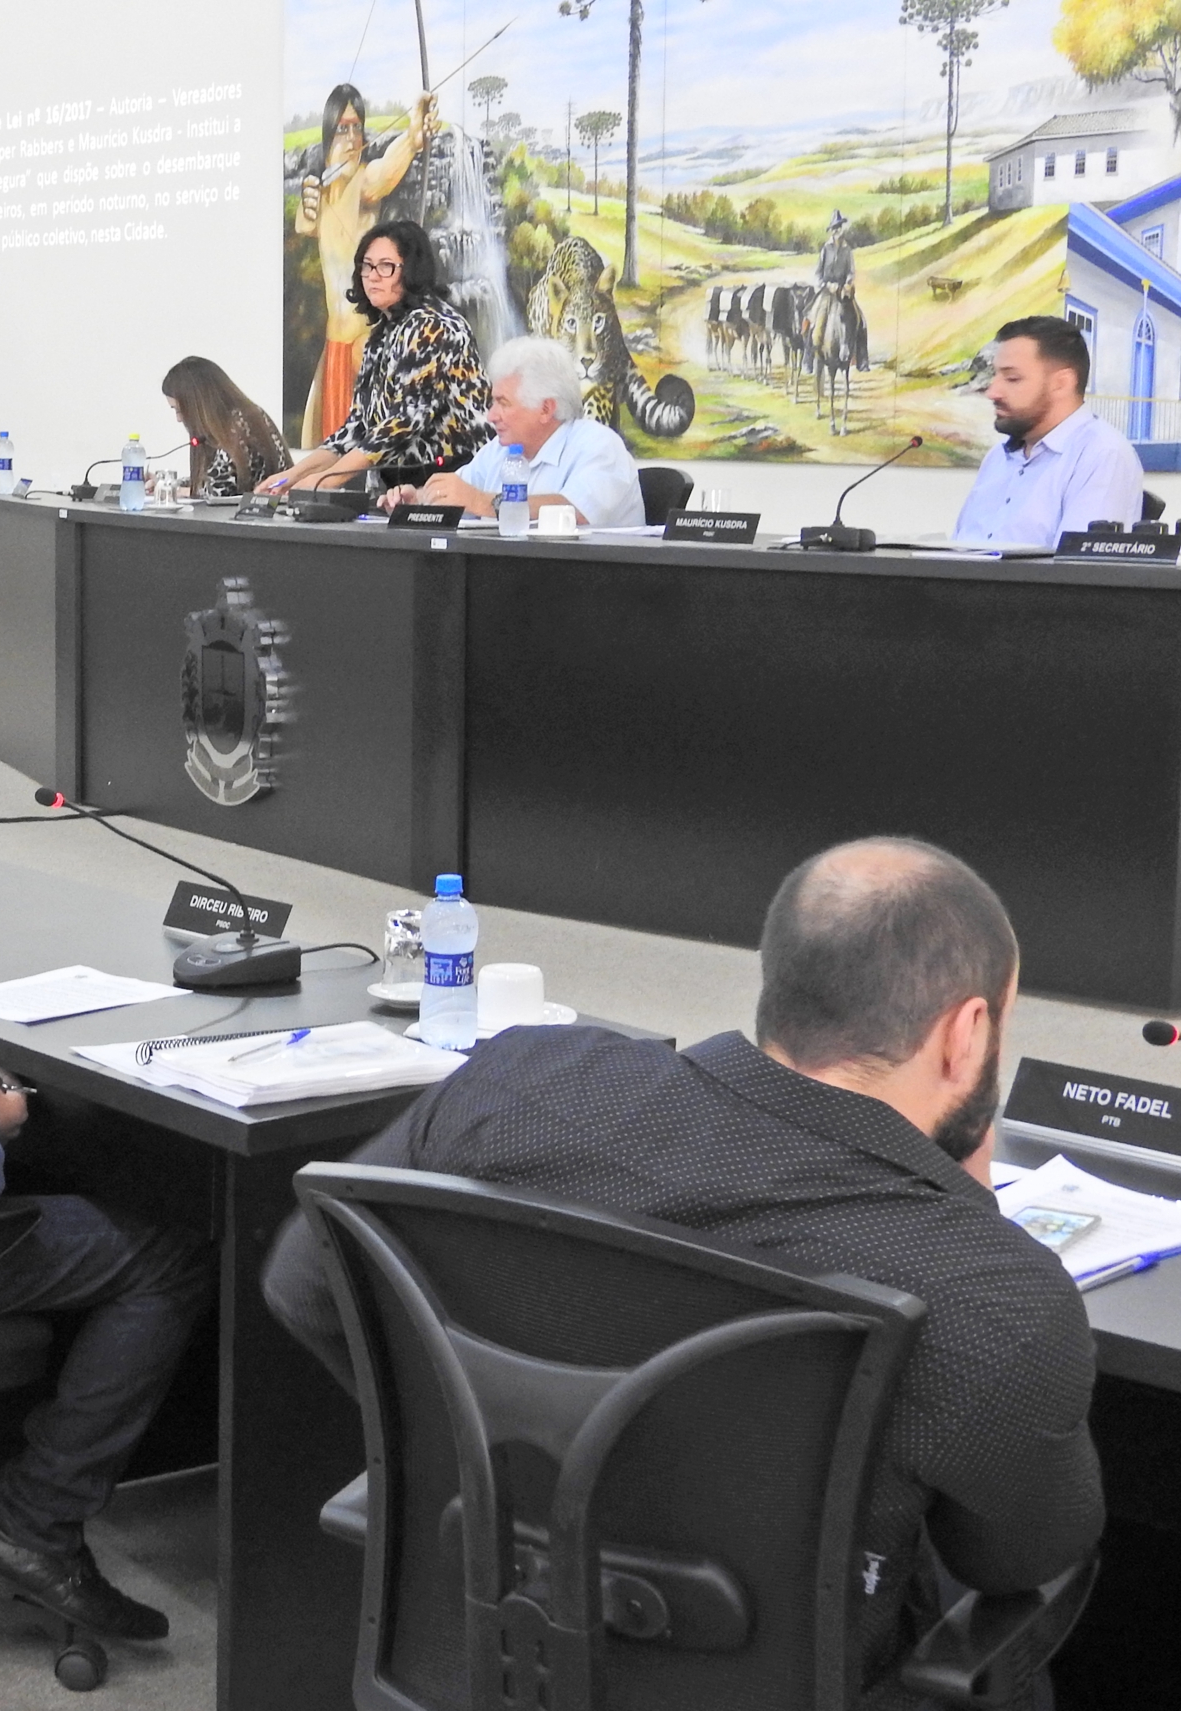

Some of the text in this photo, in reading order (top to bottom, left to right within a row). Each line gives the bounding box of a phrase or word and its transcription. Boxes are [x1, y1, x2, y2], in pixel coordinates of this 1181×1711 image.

[6, 110, 23, 130] Lei
[45, 99, 92, 127] 16/2017
[109, 92, 153, 116] Autoria
[171, 81, 242, 108] Vereadores
[19, 137, 64, 158] Rabbers
[67, 138, 75, 153] e
[78, 128, 129, 151] Maurício
[132, 122, 173, 145] Kusdra
[186, 114, 230, 139] Institui
[233, 117, 241, 133] a
[36, 170, 58, 190] que
[63, 161, 99, 186] dispõe
[104, 159, 137, 180] sobre
[142, 160, 151, 176] o
[156, 150, 241, 175] desembarque
[29, 202, 48, 217] em
[52, 194, 95, 219] período
[99, 193, 150, 211] noturno,
[154, 191, 171, 207] no
[175, 184, 219, 208] serviço
[223, 180, 240, 202] de
[1, 229, 41, 252] público
[42, 226, 89, 247] coletivo,
[90, 225, 122, 243] nesta
[123, 220, 168, 242] Cidade.
[407, 512, 444, 523] PRESIDENTE
[675, 517, 747, 529] MAURÍCIO KUSDRA
[1092, 541, 1156, 554] SECRETÁRIO
[189, 894, 269, 923] DIRCEU RIBIRO
[1062, 1081, 1172, 1119] NETO FADEL
[1101, 1114, 1121, 1127] PTB
